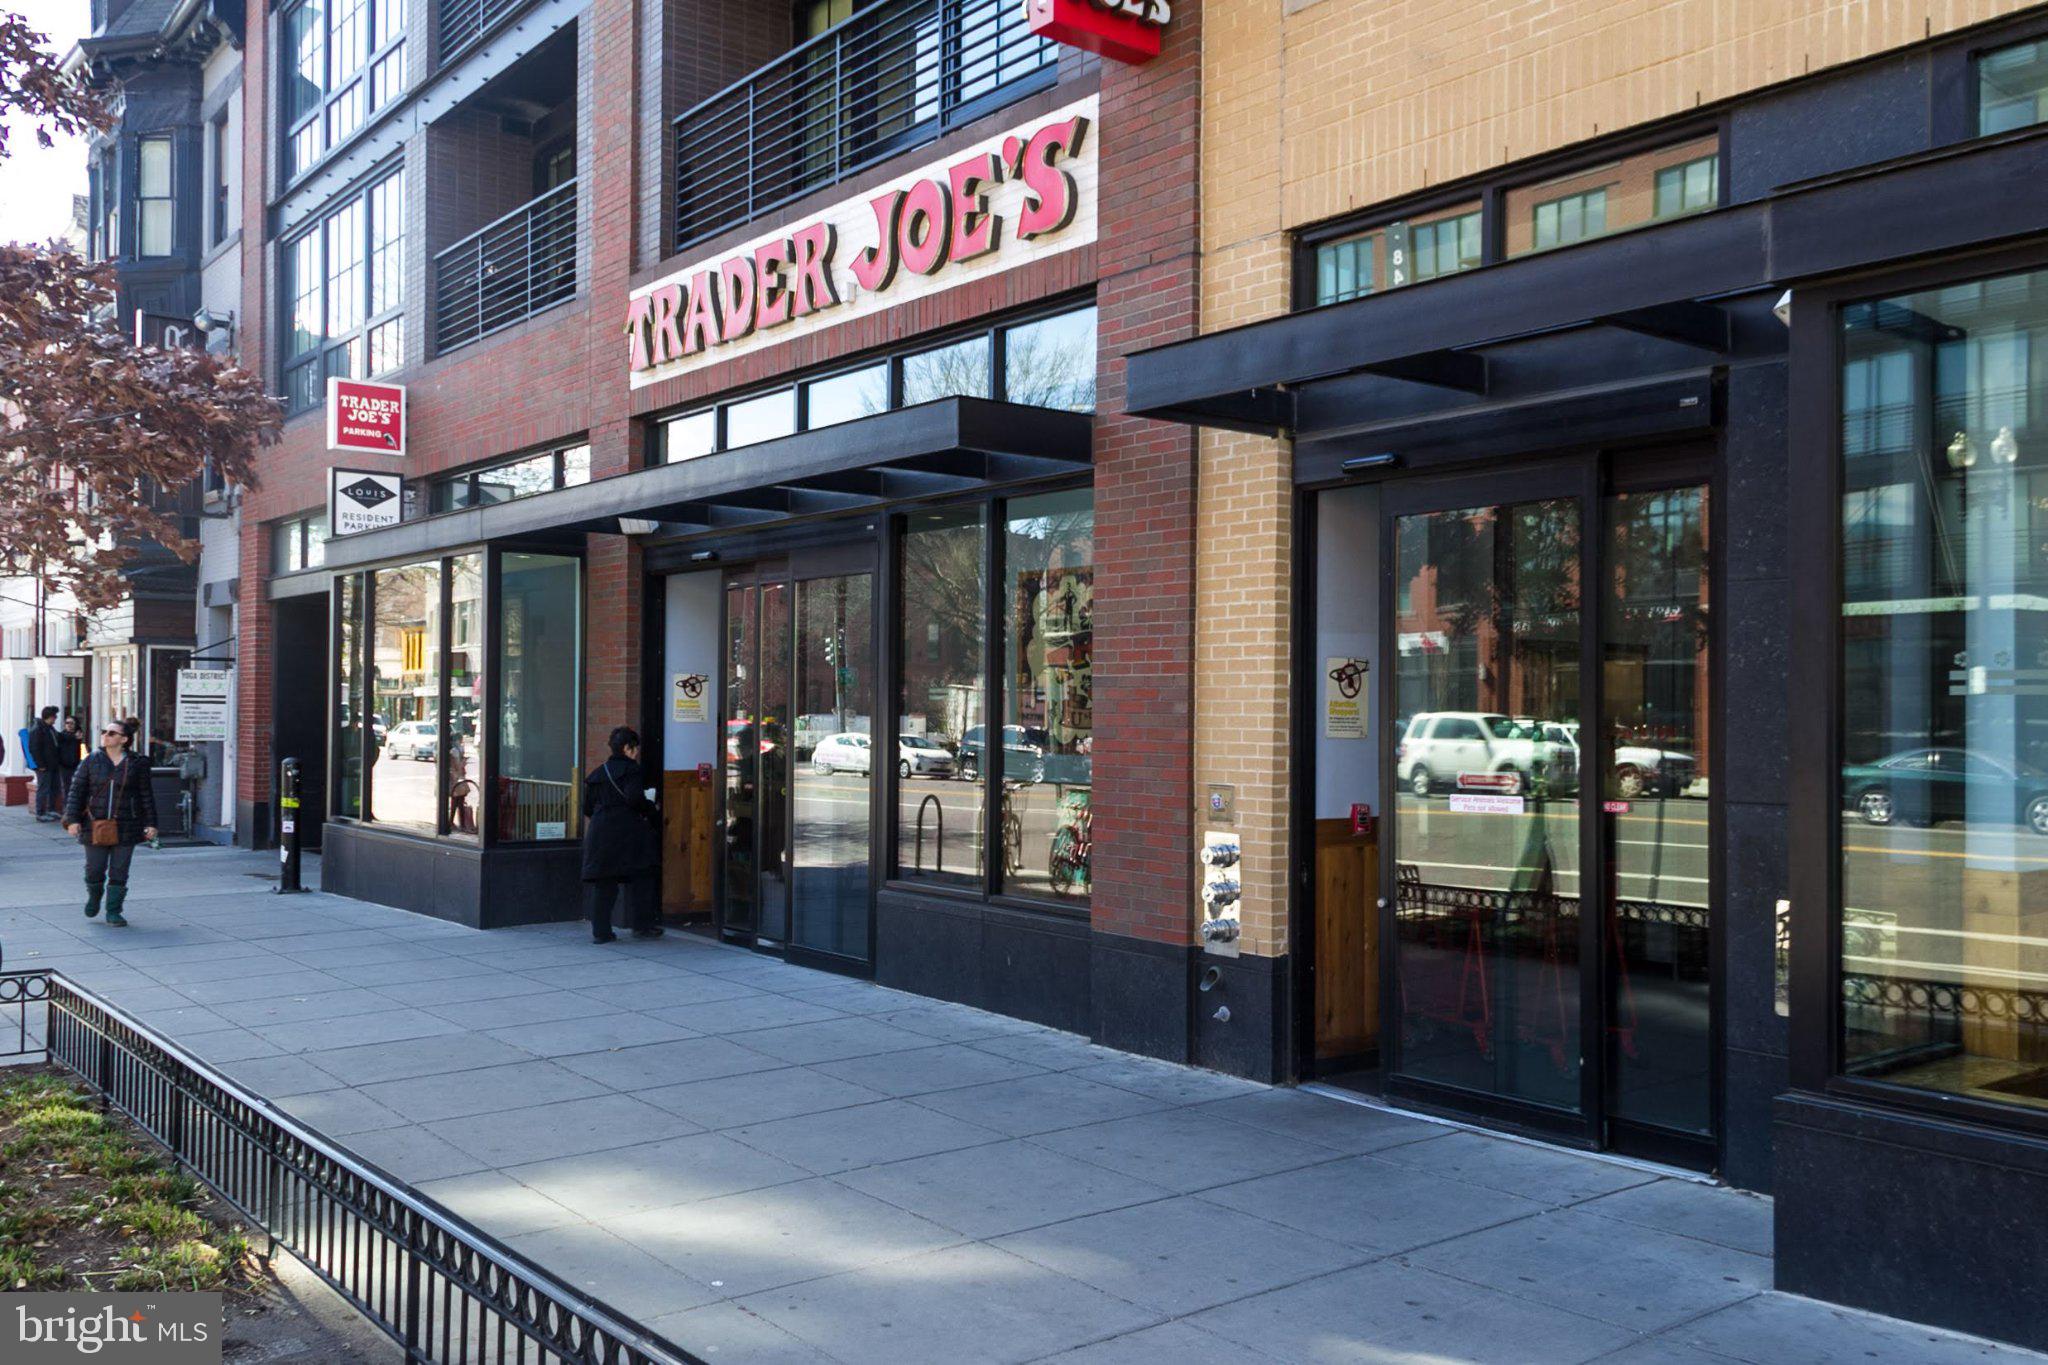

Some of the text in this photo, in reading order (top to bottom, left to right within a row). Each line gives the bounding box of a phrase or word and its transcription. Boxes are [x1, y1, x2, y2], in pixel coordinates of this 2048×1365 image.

[624, 115, 1091, 372] TRADER JOE'S
[340, 395, 400, 414] TRADER
[347, 409, 392, 425] JOE'S
[343, 426, 382, 438] PARKING
[347, 488, 387, 498] LOUIS
[342, 512, 394, 523] RESIDENT
[344, 522, 386, 531] PARK
[181, 672, 197, 680] YOGA
